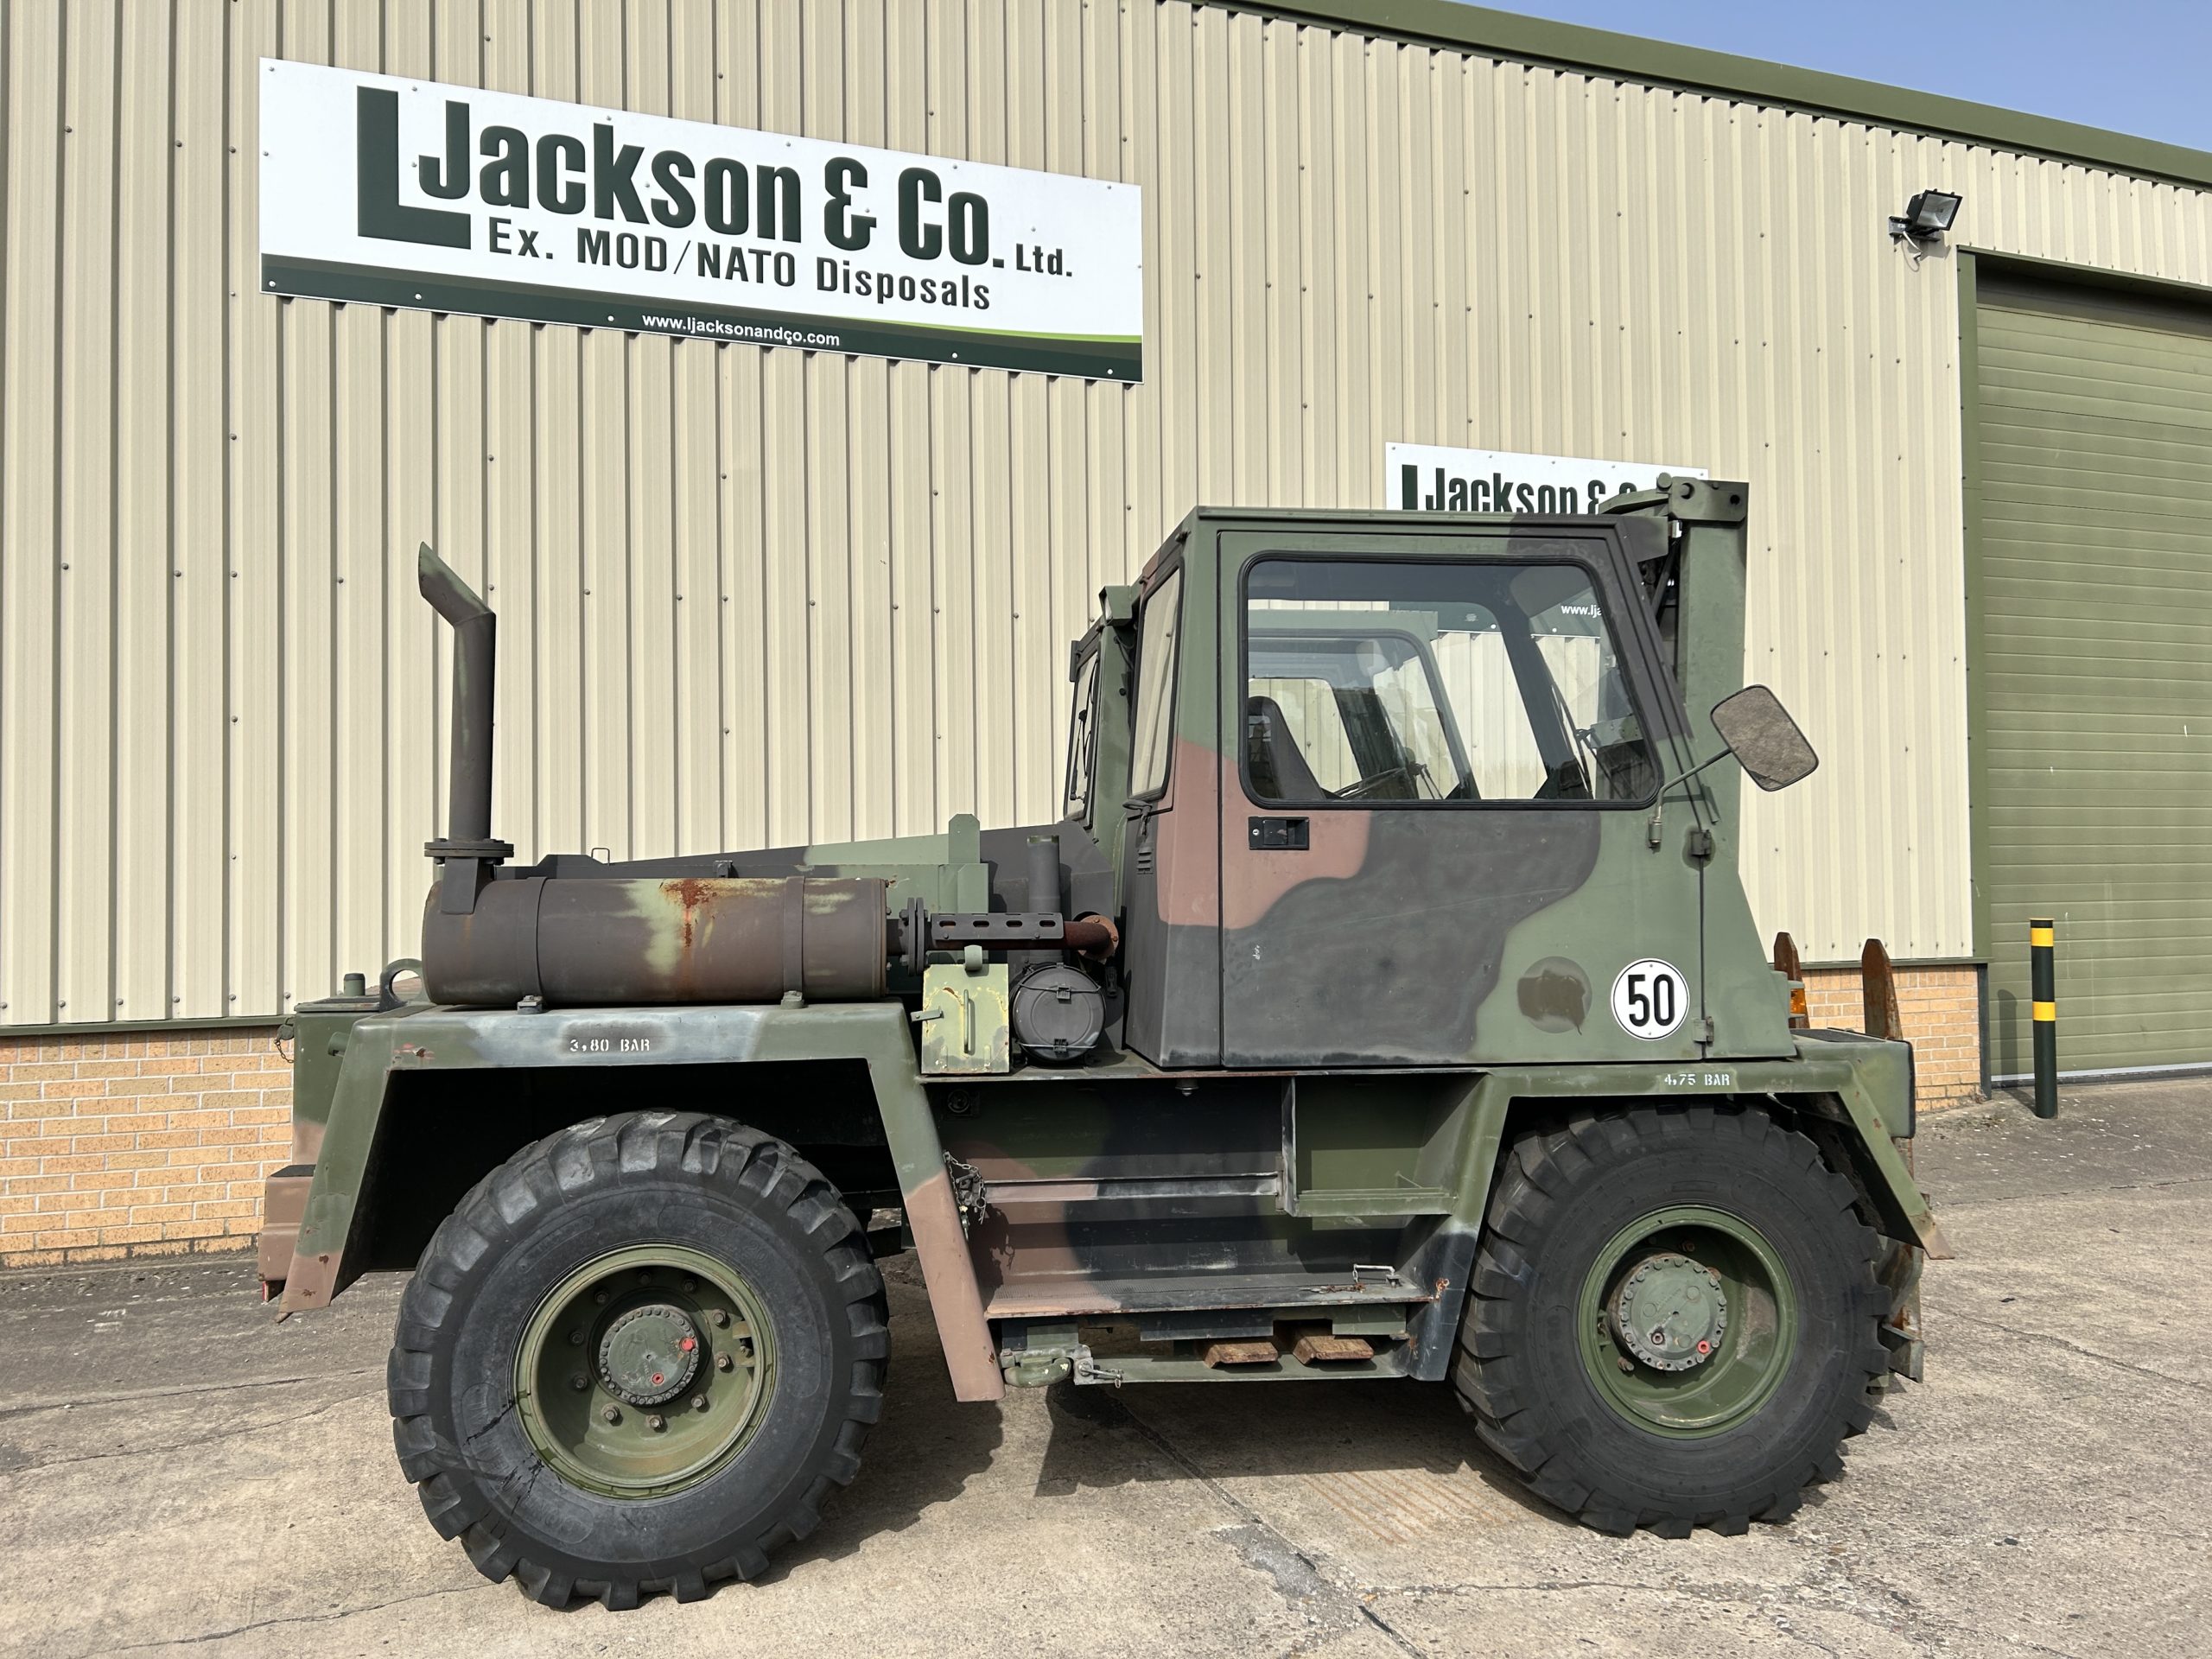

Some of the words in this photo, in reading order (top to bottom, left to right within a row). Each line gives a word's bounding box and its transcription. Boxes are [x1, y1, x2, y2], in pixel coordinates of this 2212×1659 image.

[823, 156, 877, 251] &
[898, 167, 1005, 268] Co.
[1015, 243, 1073, 277] Ltd.
[489, 216, 554, 260] Ex.
[577, 227, 796, 287] MOD/NATO
[817, 257, 990, 310] Disposals
[642, 315, 840, 346] www.ljacksonandco.com
[1628, 974, 1675, 1027] 50
[569, 1039, 609, 1052] 3,80
[620, 1039, 650, 1052] BAR
[1664, 1073, 1696, 1085] 4,75
[1704, 1073, 1730, 1085] BAR
